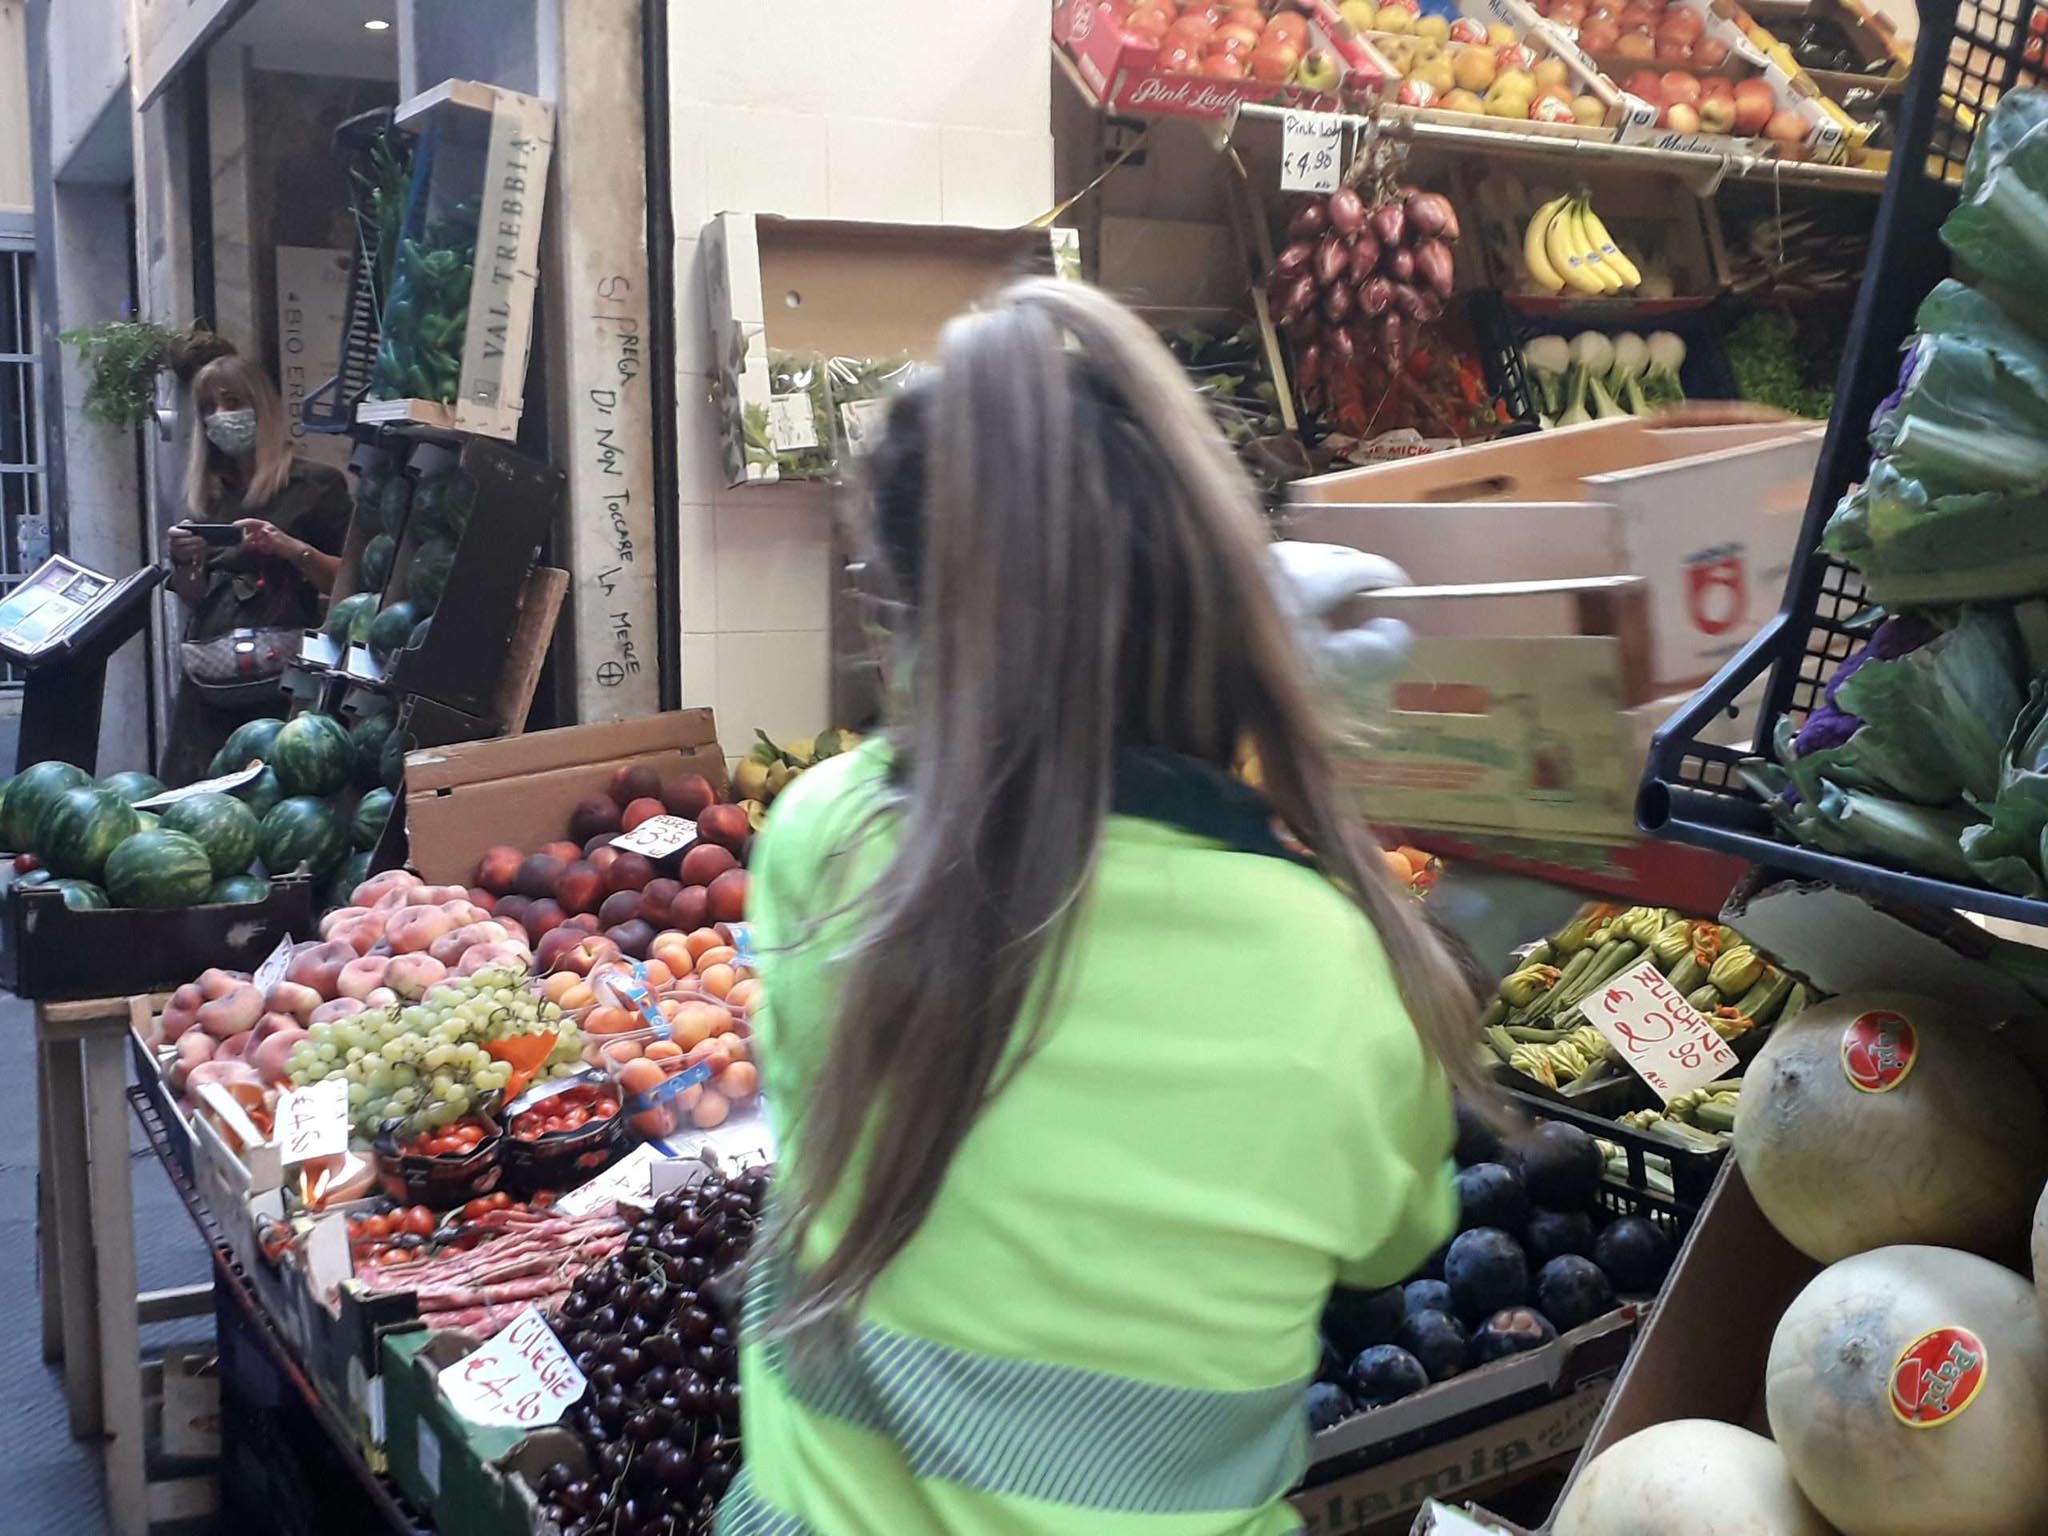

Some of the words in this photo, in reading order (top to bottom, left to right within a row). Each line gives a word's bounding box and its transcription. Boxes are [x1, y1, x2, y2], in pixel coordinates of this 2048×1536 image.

[1130, 77, 1191, 103] Pink
[1286, 115, 1317, 136] Pink
[492, 138, 531, 286] TREBBIA
[483, 303, 511, 360] VAL
[592, 313, 640, 386] PREGA
[590, 389, 616, 414] DI
[596, 429, 624, 476] NON
[602, 489, 635, 563] TOCCARE
[598, 566, 613, 598] LA
[610, 612, 640, 674] MERCE
[1632, 966, 1734, 1063] ZUCCHINE
[1920, 1340, 1980, 1413] Papi
